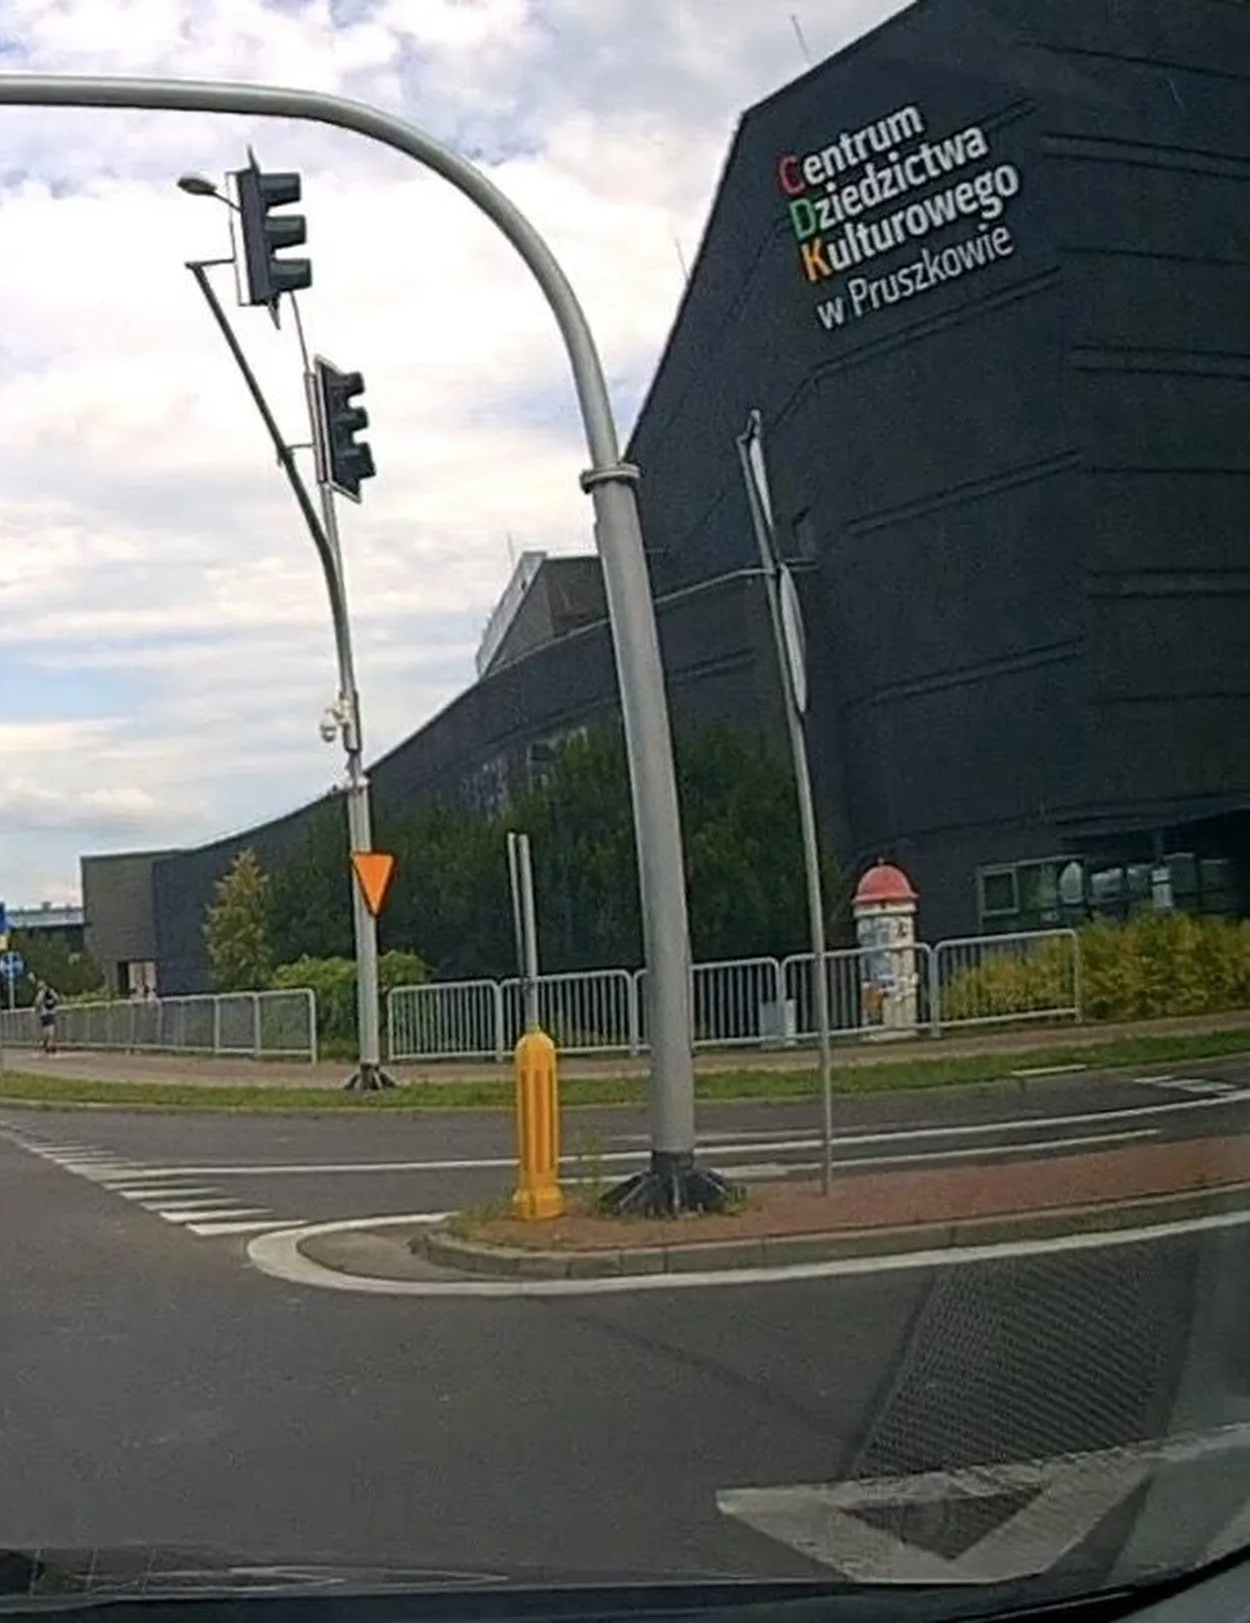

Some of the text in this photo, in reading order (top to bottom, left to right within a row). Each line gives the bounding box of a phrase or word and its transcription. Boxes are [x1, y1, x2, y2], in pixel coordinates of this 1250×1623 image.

[778, 105, 925, 194] Centrum
[789, 126, 989, 239] Dziedzictwa
[801, 164, 1019, 281] Kulturowego
[817, 222, 1014, 330] w Pruszkowie
